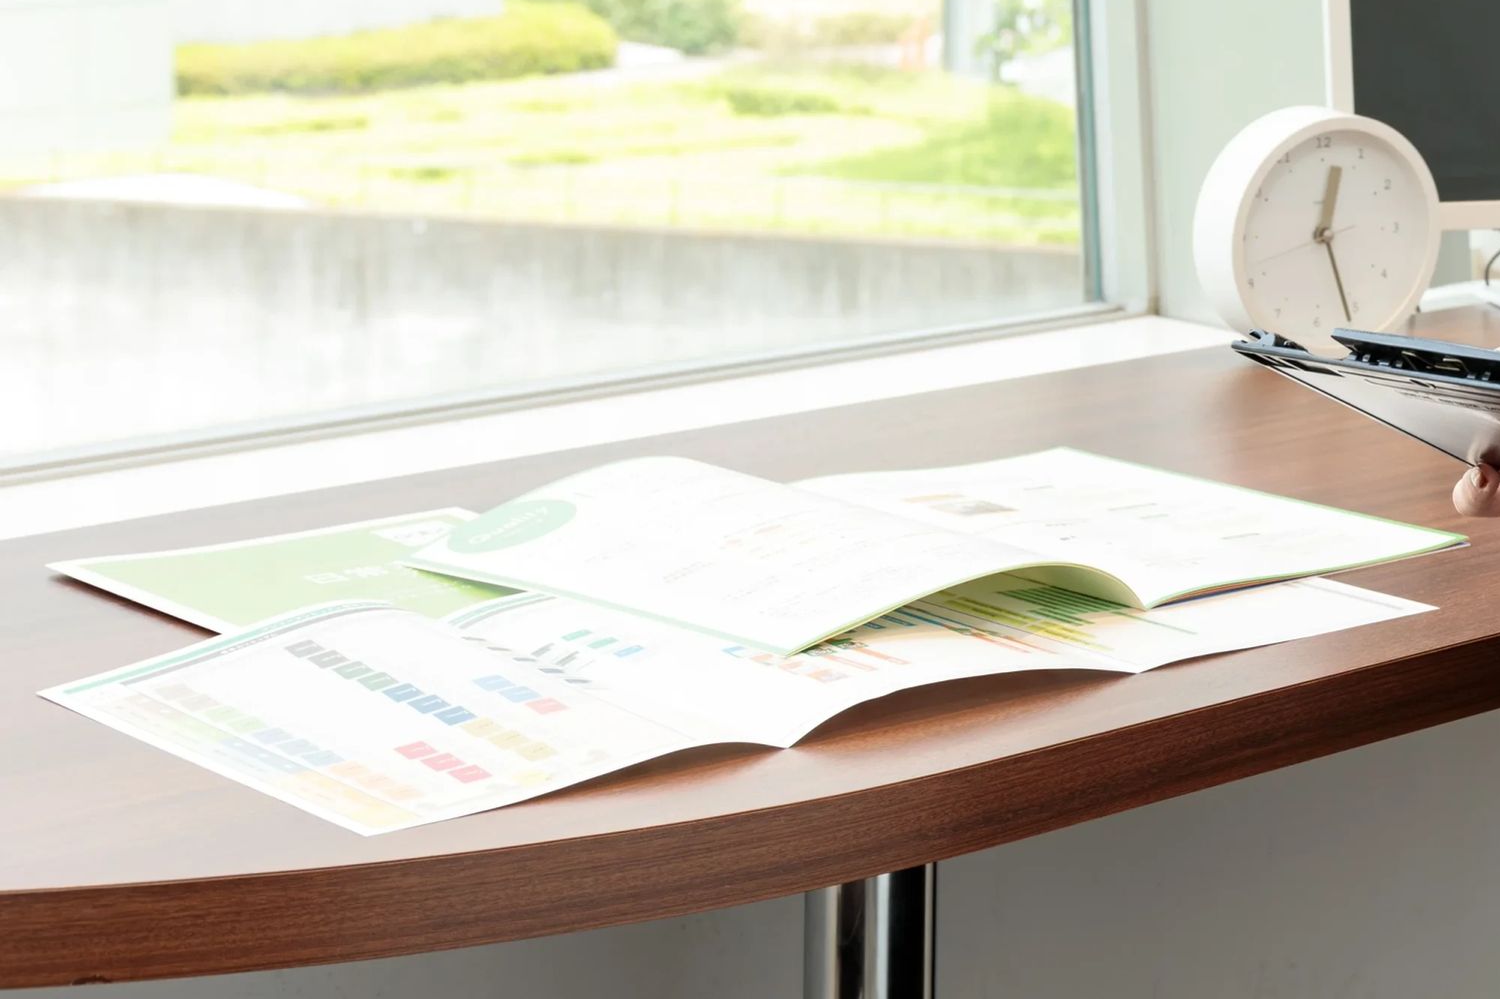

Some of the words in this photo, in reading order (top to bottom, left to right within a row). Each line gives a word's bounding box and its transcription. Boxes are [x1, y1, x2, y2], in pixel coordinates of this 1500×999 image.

[1315, 136, 1332, 149] 12
[1357, 148, 1365, 160] 1
[1383, 178, 1392, 191] 2
[1392, 221, 1400, 234] 3
[1380, 268, 1388, 279] 4
[1274, 307, 1282, 319] 7
[1351, 301, 1360, 313] 5
[1312, 316, 1321, 328] 6
